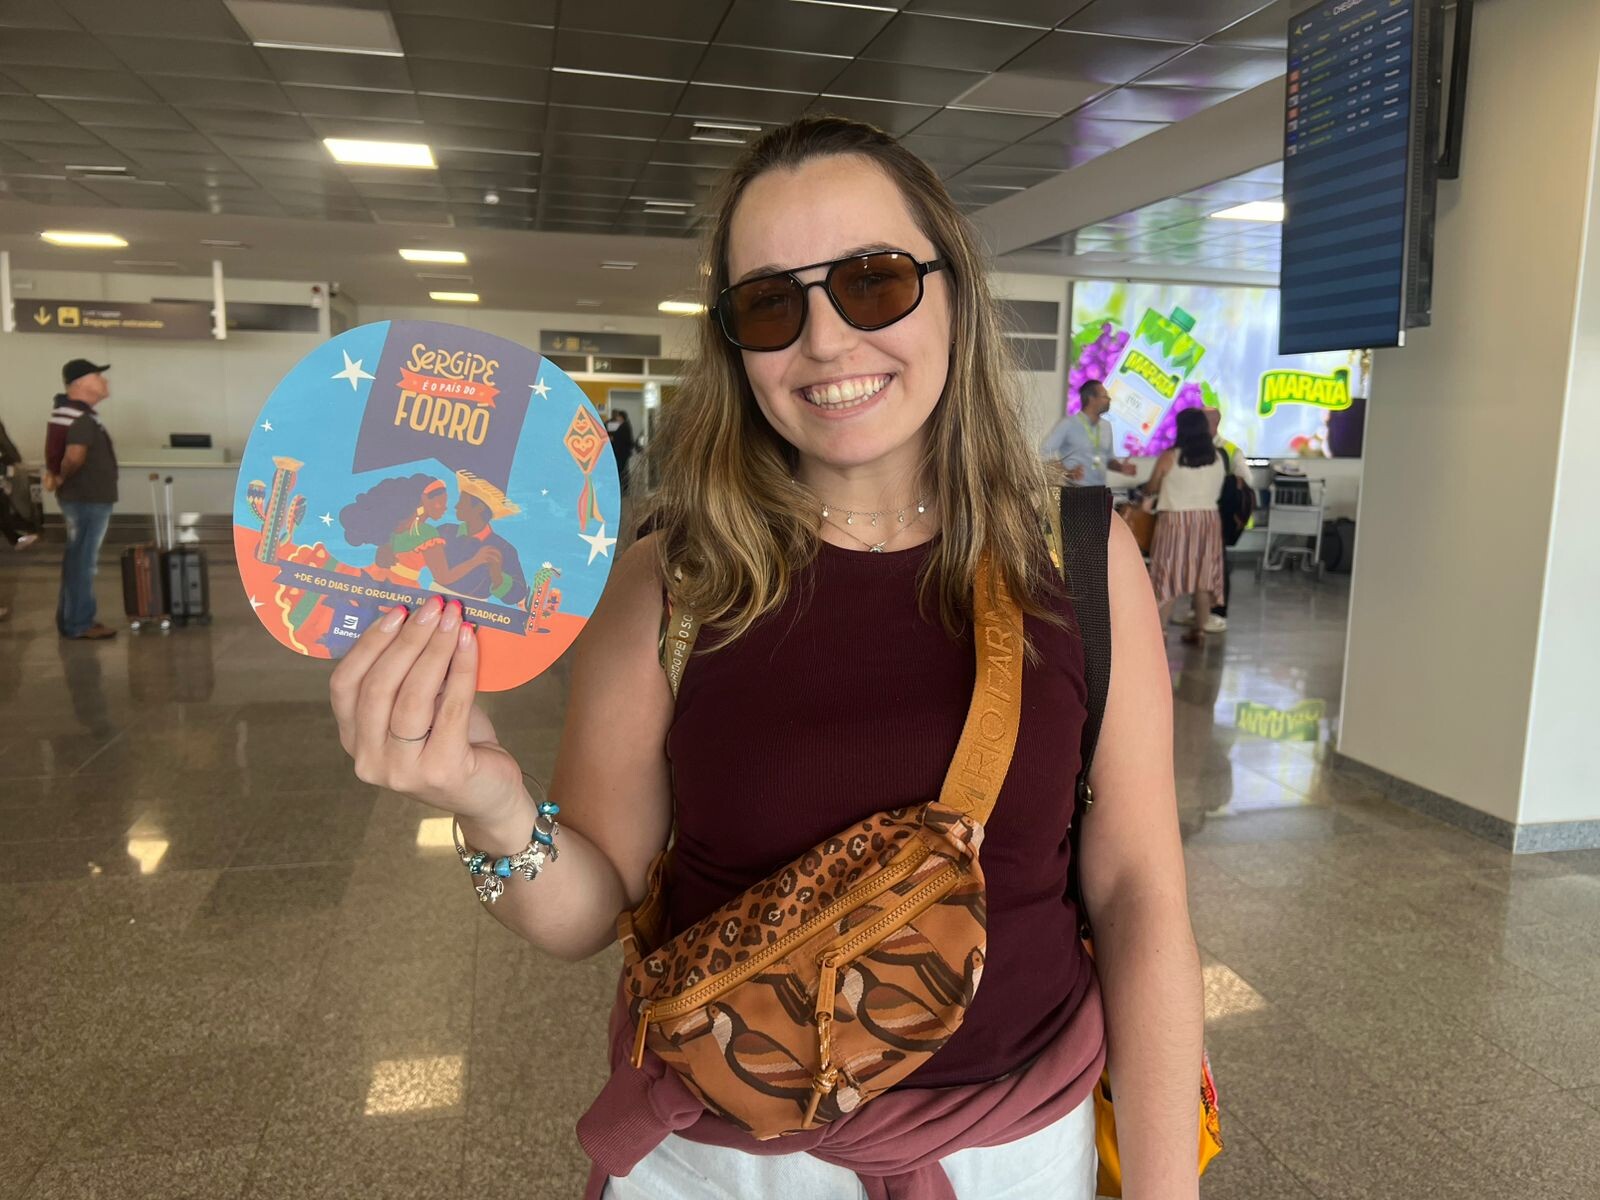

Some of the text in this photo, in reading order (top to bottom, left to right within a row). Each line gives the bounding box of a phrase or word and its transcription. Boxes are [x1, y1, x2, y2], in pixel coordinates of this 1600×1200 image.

[421, 379, 476, 396] É O PAÍS DO
[394, 389, 490, 446] FORRÓ
[314, 578, 327, 587] 60
[328, 580, 350, 593] DIAS
[351, 584, 365, 596] DE
